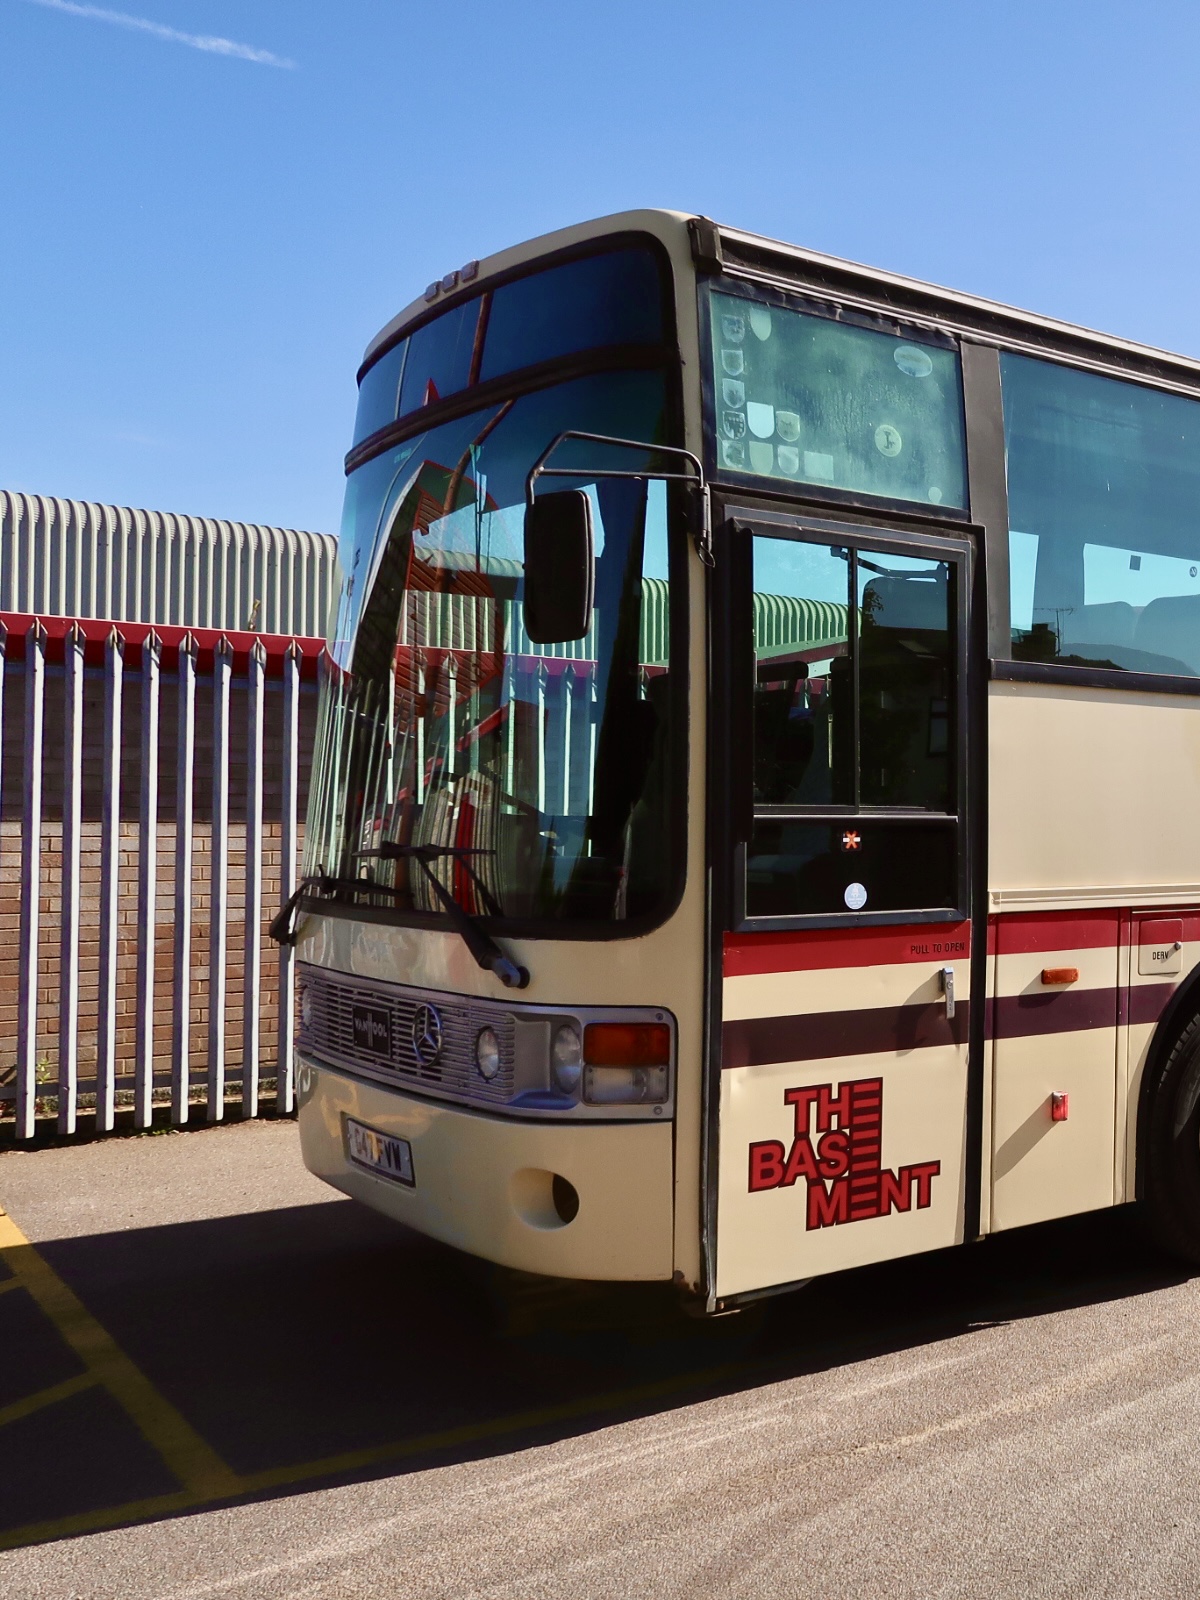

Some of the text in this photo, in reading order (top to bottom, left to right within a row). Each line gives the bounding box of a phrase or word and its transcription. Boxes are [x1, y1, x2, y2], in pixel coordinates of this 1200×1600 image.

[910, 942, 965, 954] PULL TO OPEN
[1152, 951, 1169, 960] DERV
[784, 1077, 883, 1138] THE
